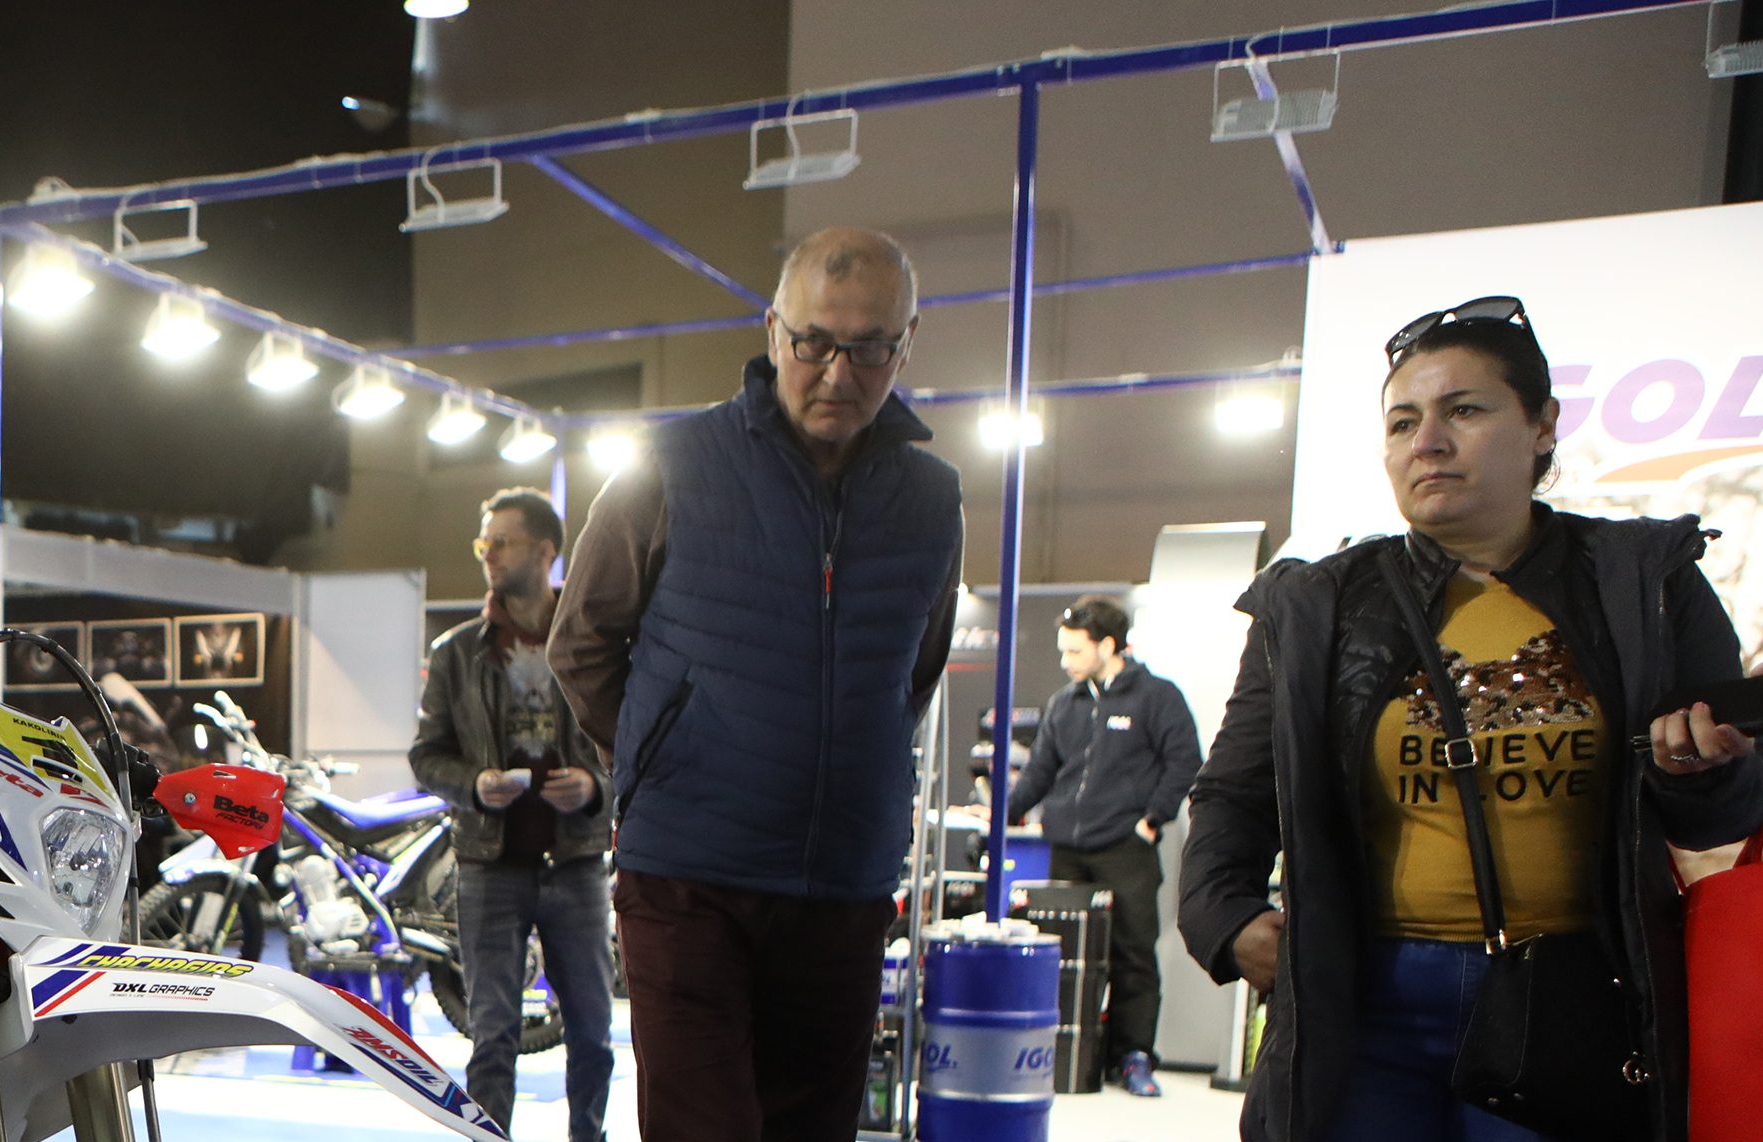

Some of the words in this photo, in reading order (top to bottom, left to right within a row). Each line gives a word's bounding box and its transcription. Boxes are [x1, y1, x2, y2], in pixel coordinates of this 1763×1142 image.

[1399, 729, 1596, 766] BEIEVE
[1399, 772, 1439, 804] IN
[1479, 769, 1593, 802] OVE
[214, 795, 270, 823] Beta
[341, 1026, 441, 1085] AMSOIL
